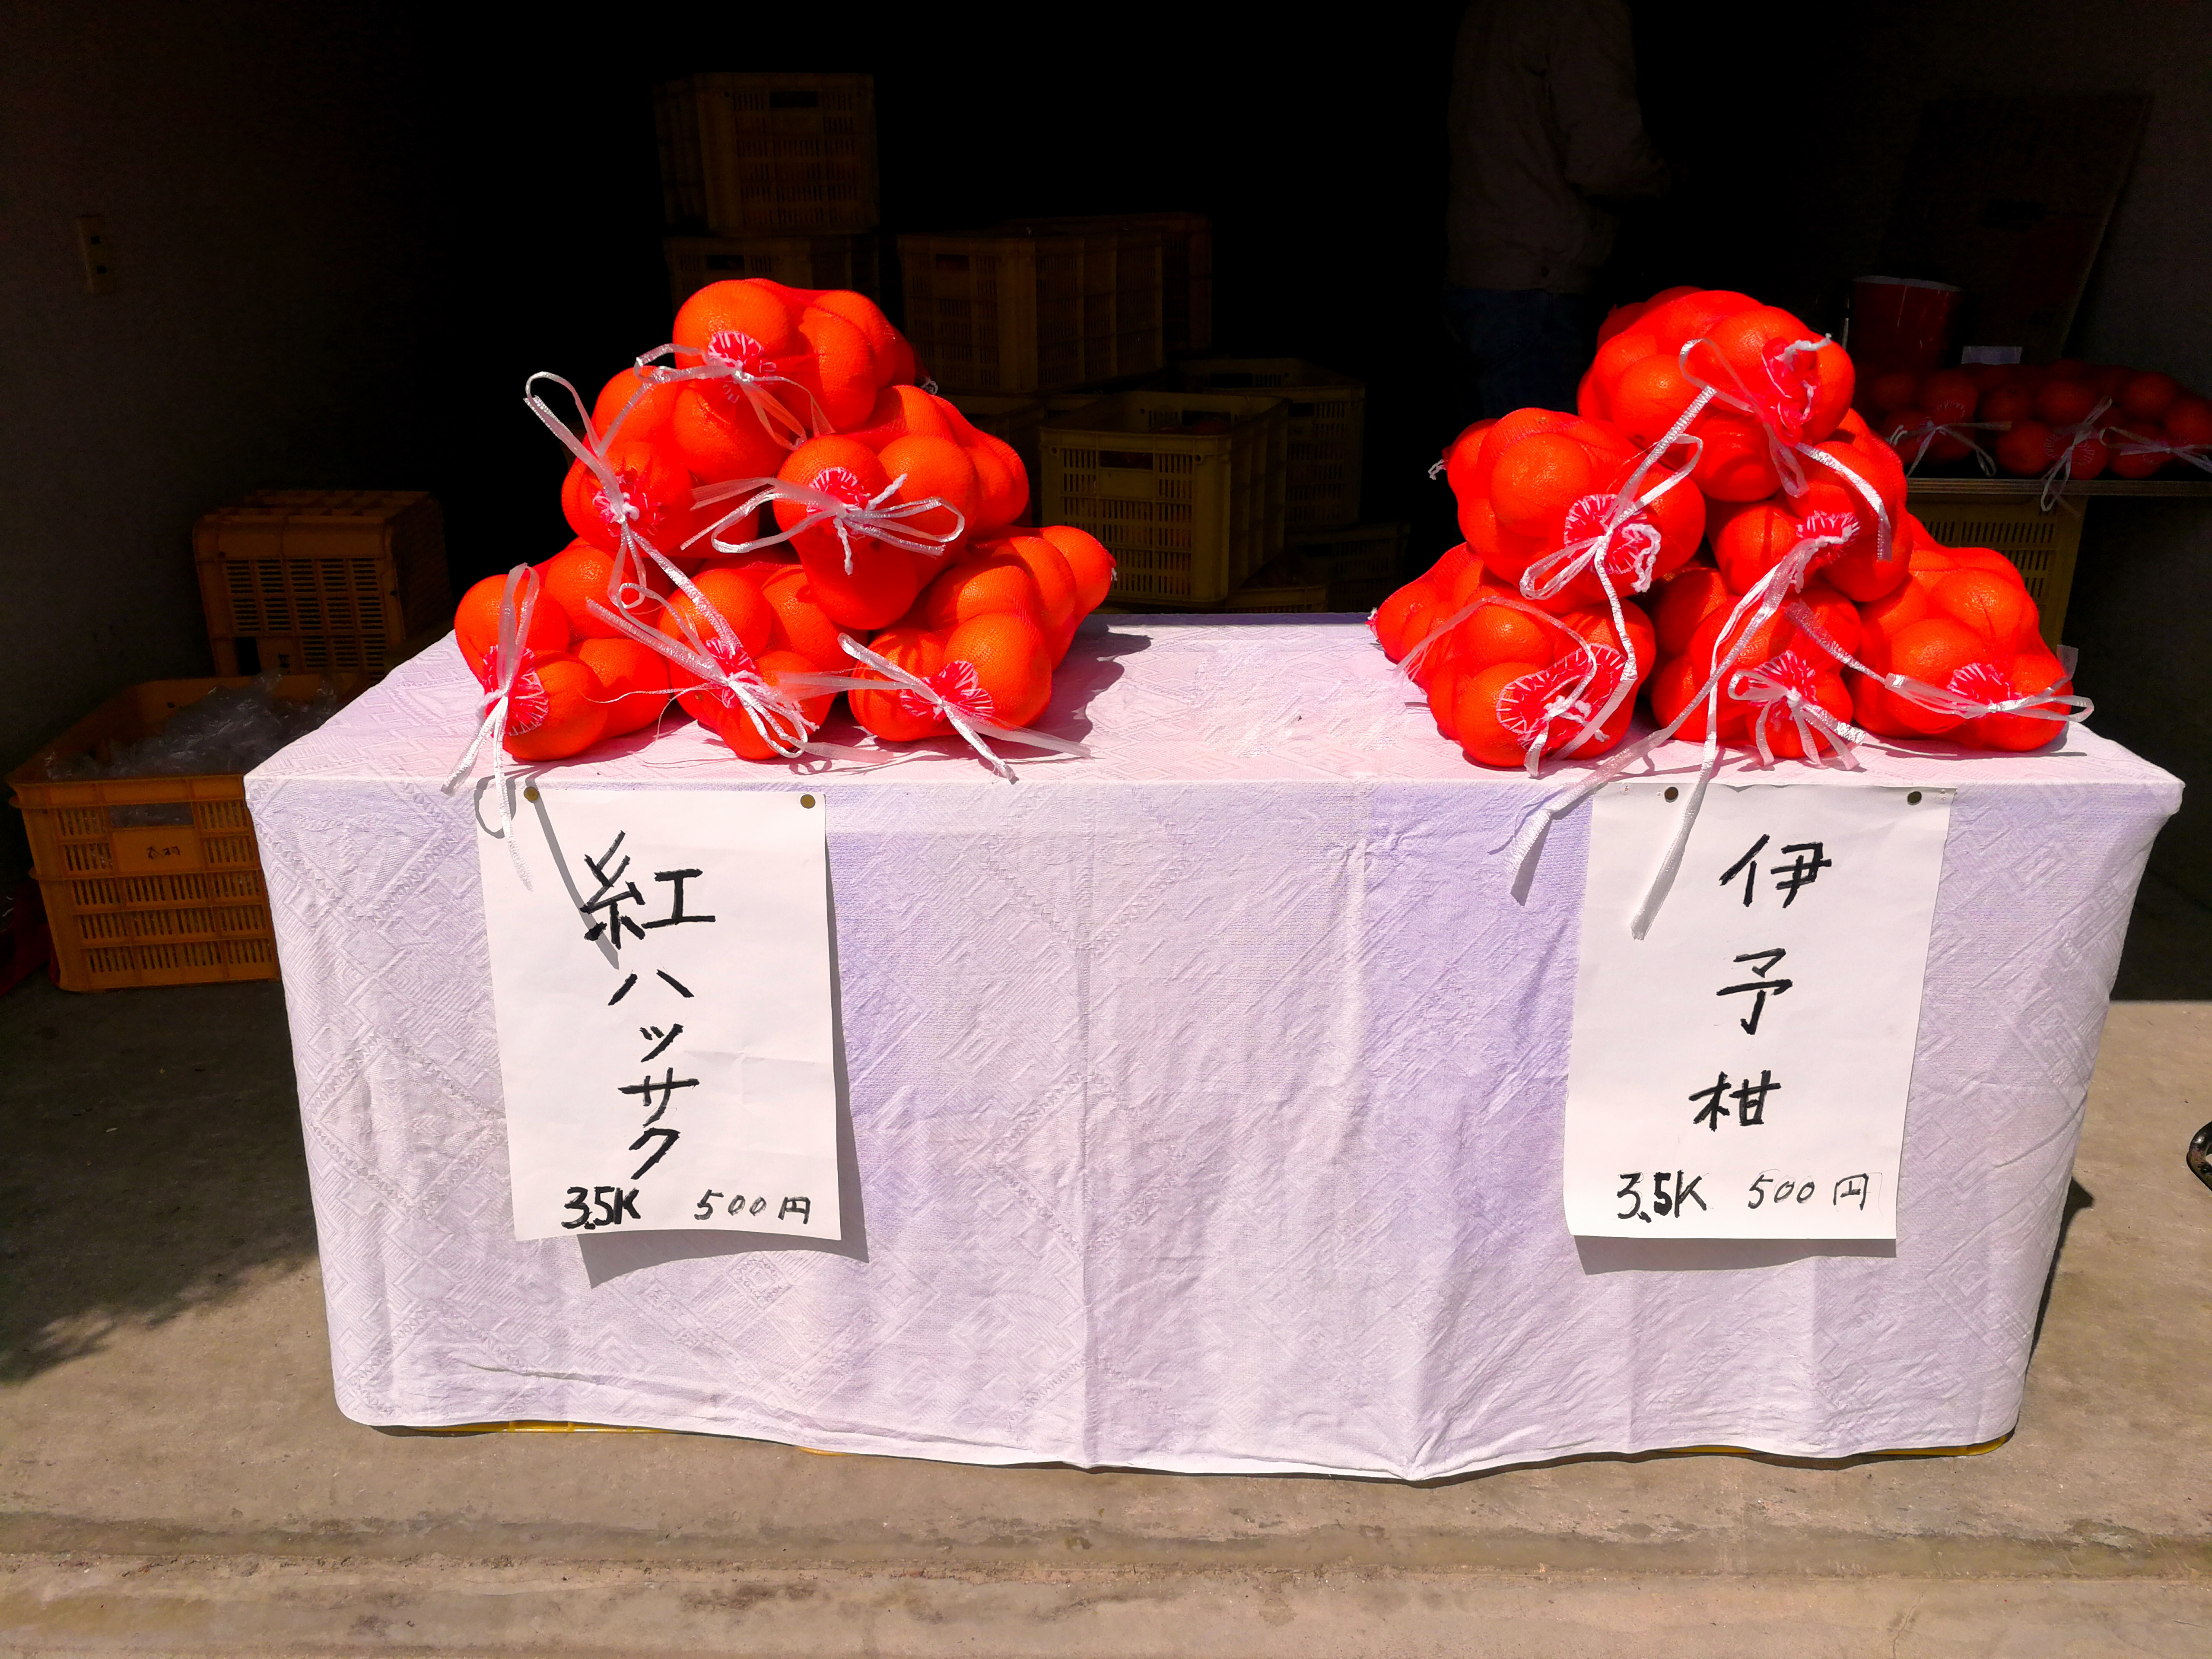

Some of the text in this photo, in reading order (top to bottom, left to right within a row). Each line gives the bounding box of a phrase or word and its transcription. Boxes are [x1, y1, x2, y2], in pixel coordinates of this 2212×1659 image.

[579, 830, 716, 1180] 紅ハッサク
[1688, 834, 1832, 1132] 伊予柑
[561, 1186, 641, 1230] 3.5K
